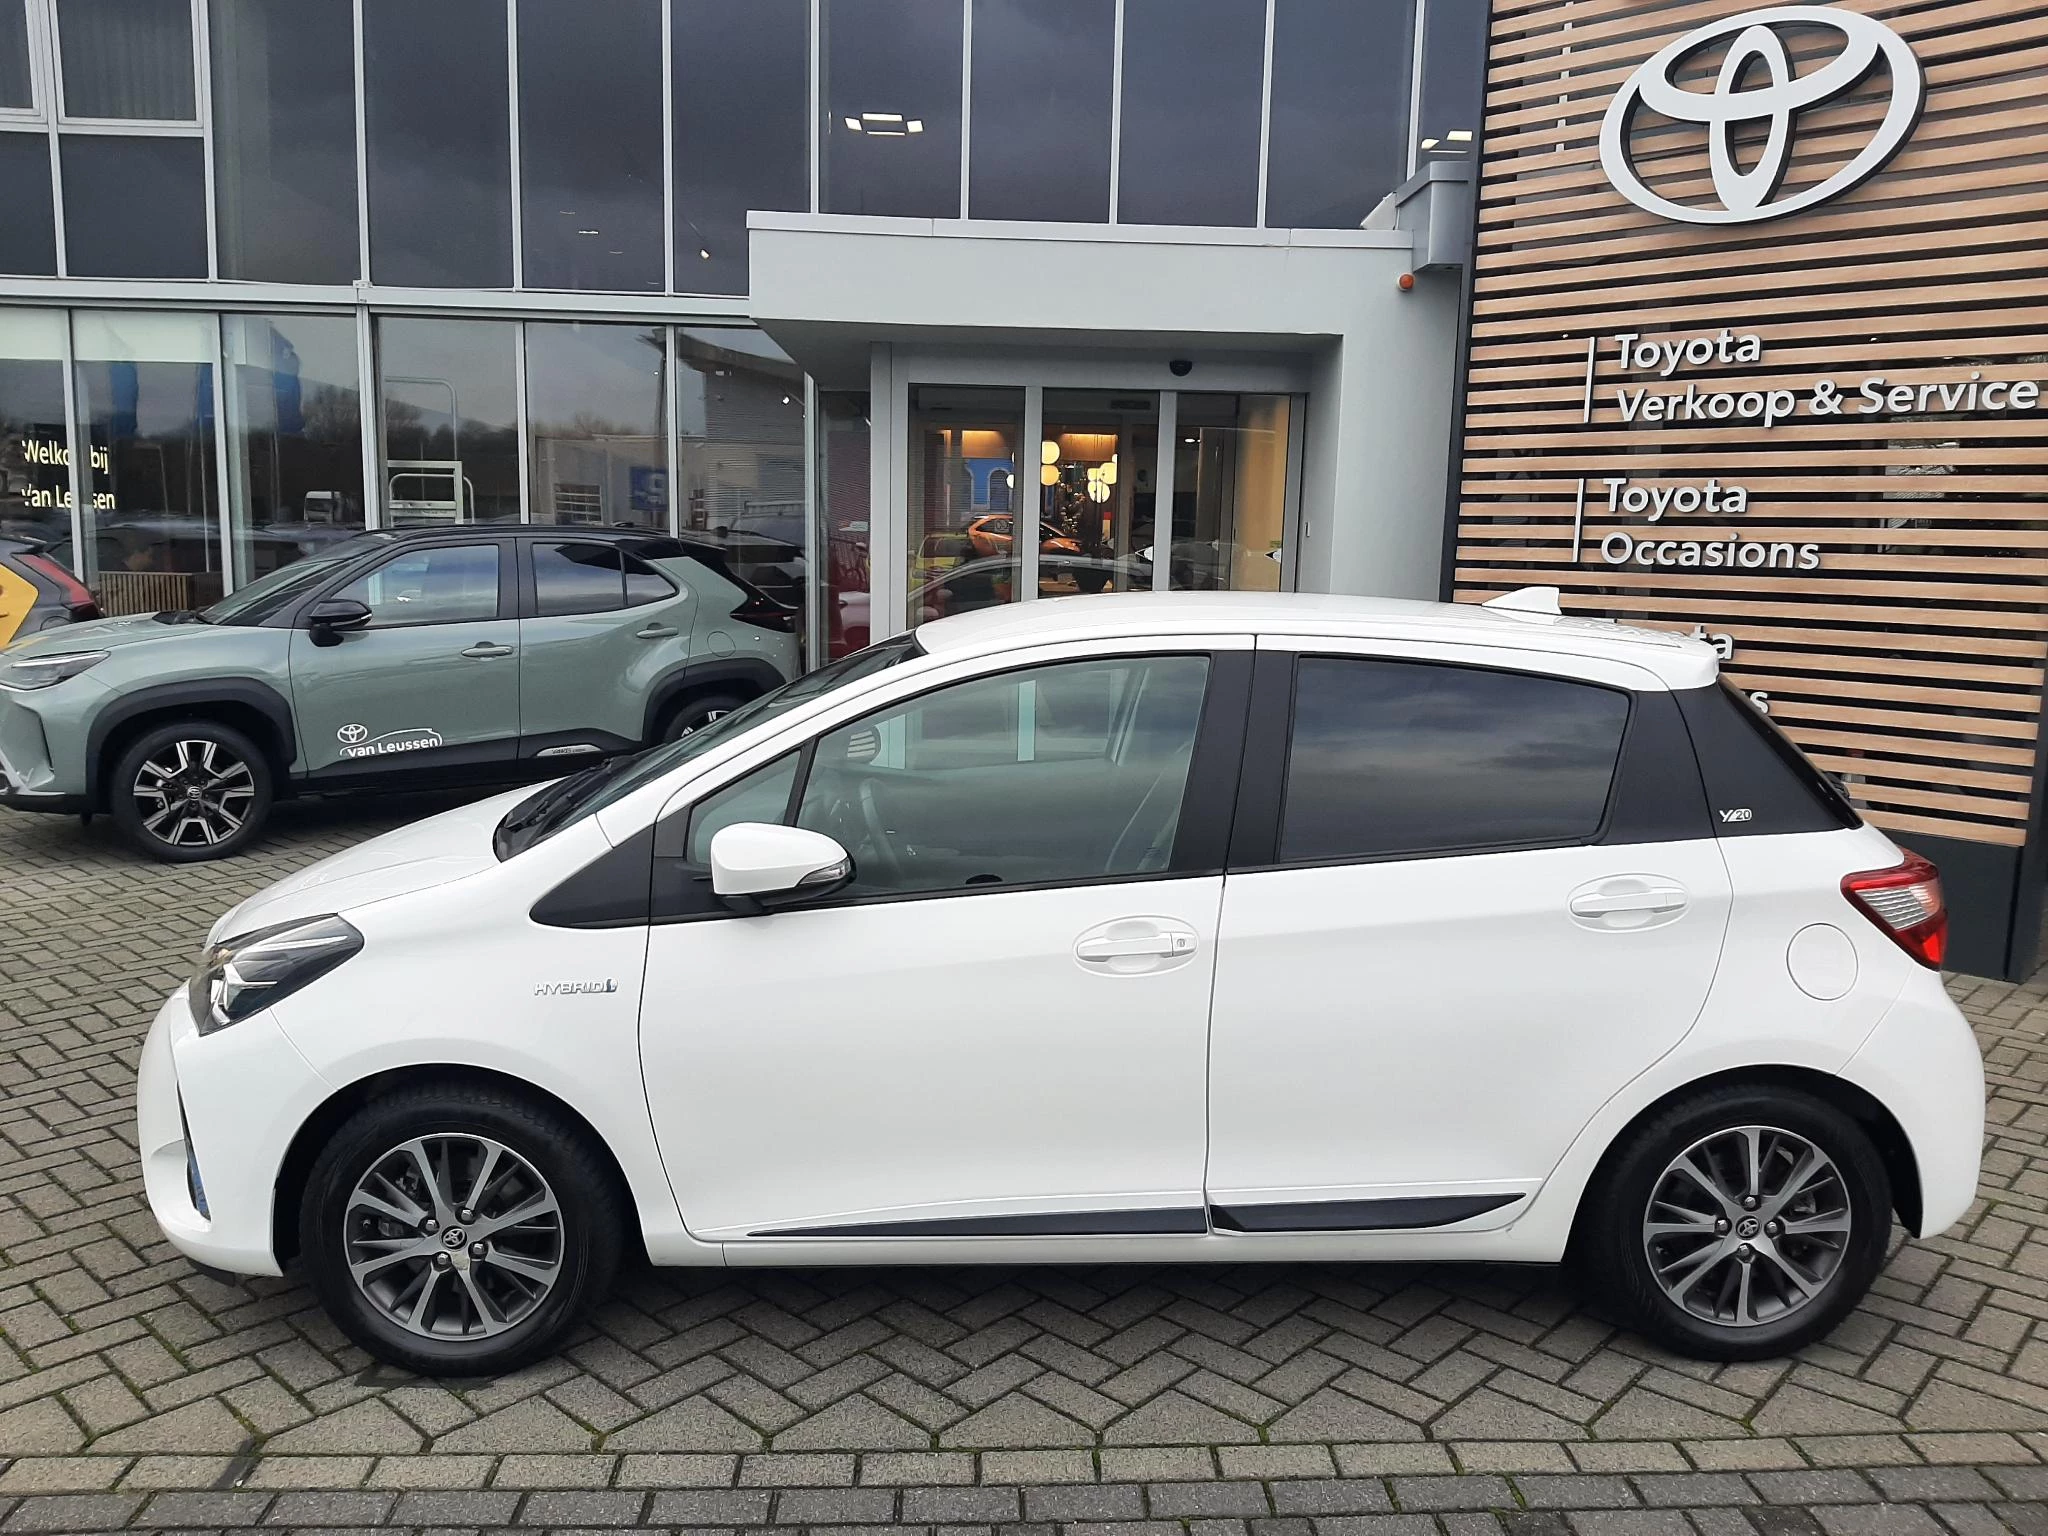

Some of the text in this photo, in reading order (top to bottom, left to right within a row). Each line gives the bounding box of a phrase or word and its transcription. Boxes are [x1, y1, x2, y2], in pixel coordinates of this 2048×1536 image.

[1615, 329, 1761, 377] Toyota
[1616, 371, 2040, 428] Verkoop & Service
[21, 439, 109, 475] Welko bij
[55, 484, 116, 510] Lesen
[1602, 478, 1748, 522] Toyota
[1601, 531, 1820, 570] Occasions
[347, 737, 438, 757] van Leussen
[534, 981, 605, 996] HYBRID
